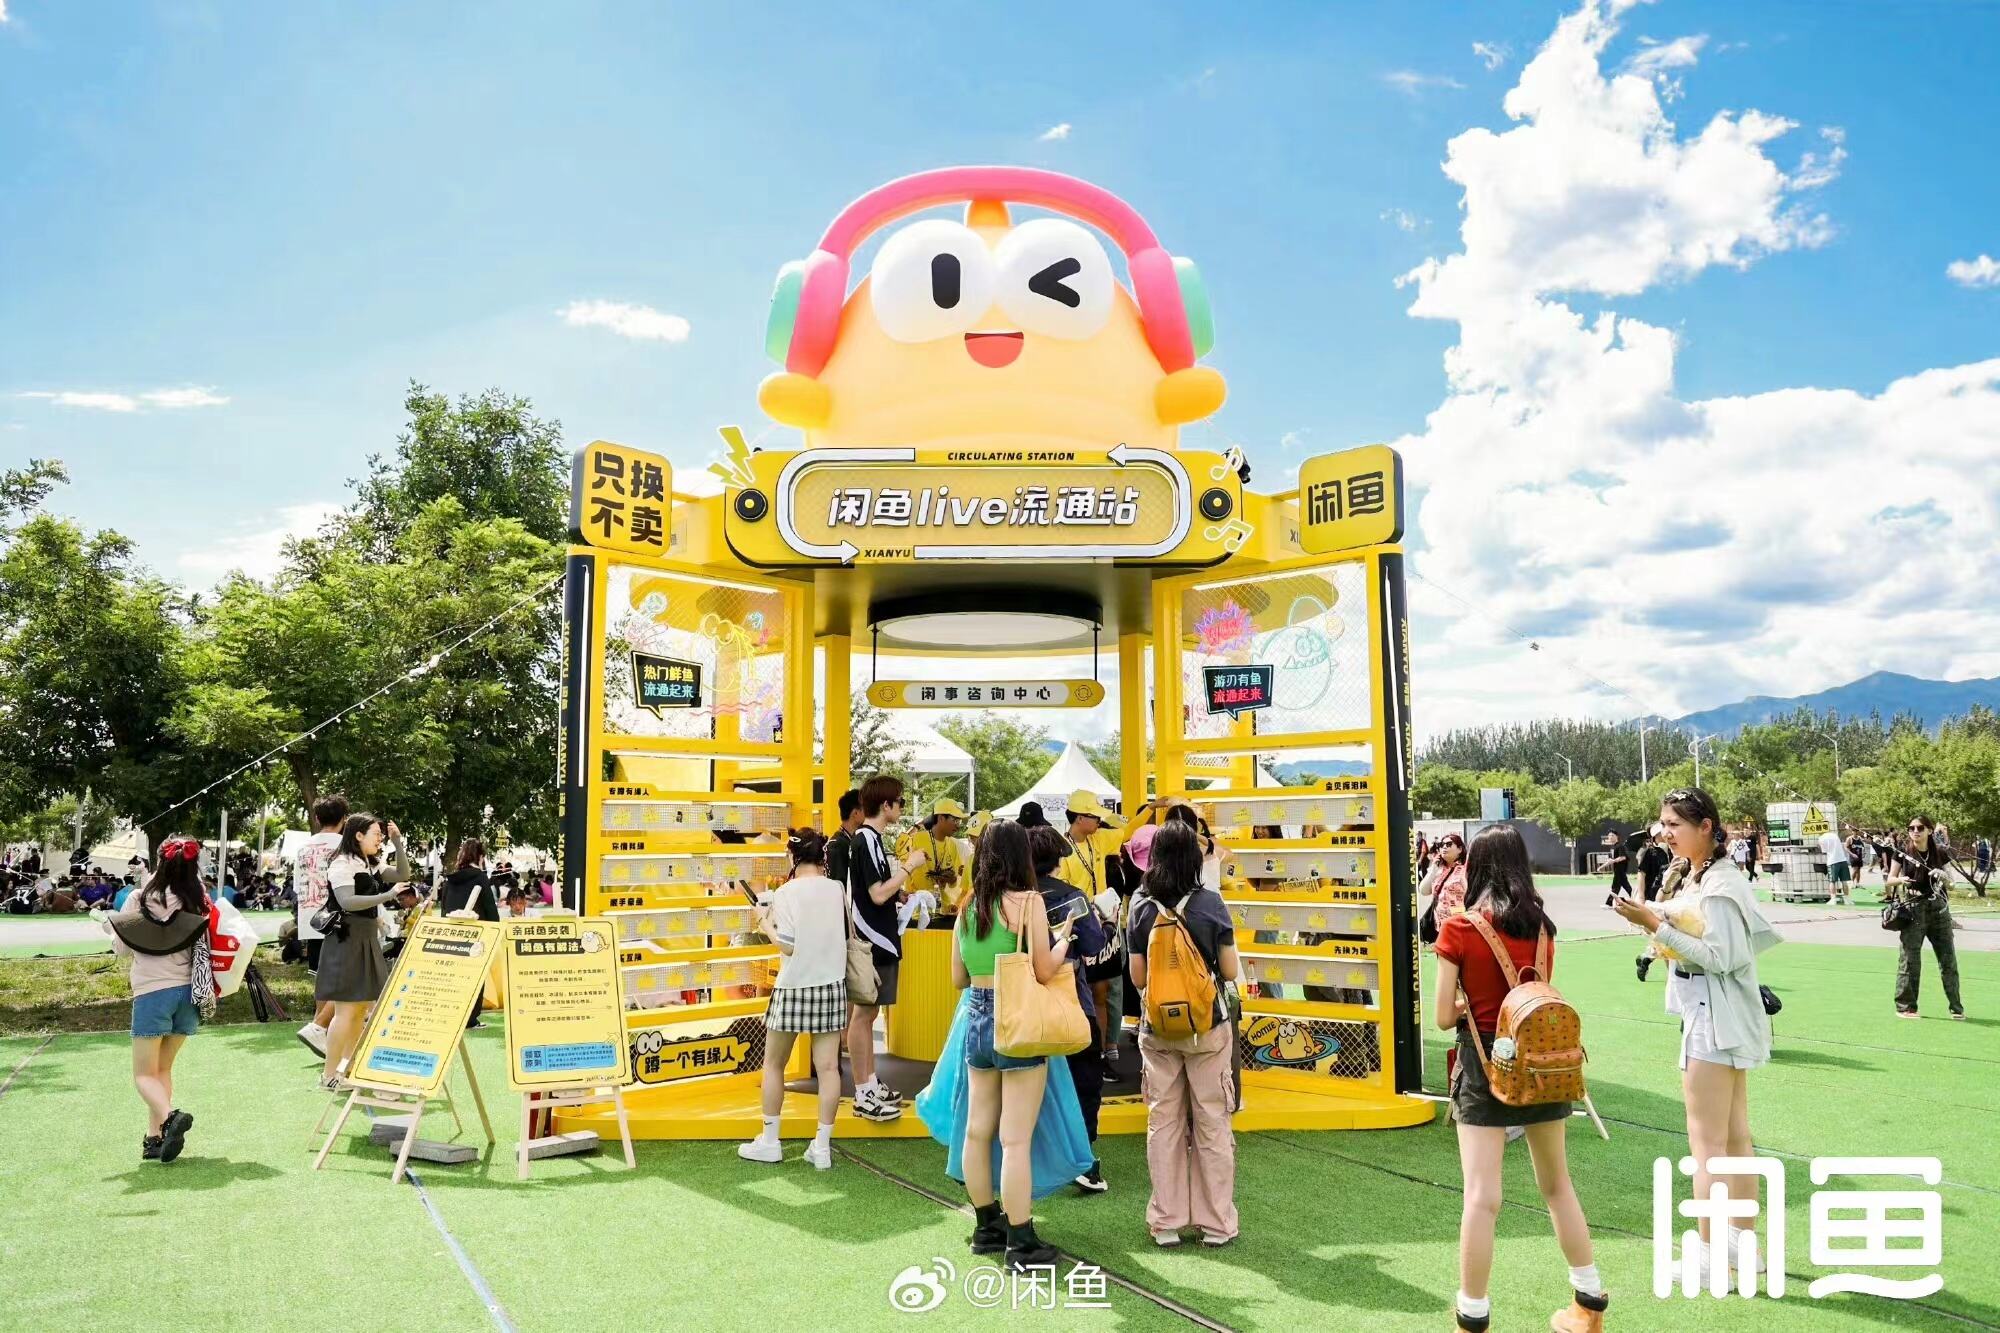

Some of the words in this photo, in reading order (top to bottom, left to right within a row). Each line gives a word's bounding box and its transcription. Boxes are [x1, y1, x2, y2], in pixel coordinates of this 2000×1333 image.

[947, 451, 1023, 461] CIRCULATING
[1027, 452, 1075, 461] STATION
[591, 450, 665, 503] 只换
[827, 485, 1140, 528] 闲鱼live流通站
[1307, 470, 1385, 526] 闲鱼
[590, 495, 664, 546] 不卖
[864, 549, 911, 558] XIANYU
[562, 620, 571, 678] XIANYU
[643, 664, 694, 682] 热门鲜鱼
[1213, 671, 1262, 688] 游刃有鱼
[643, 681, 694, 698] 流通起来
[920, 685, 1052, 702] 闲事咨询中心
[1213, 686, 1263, 703] 流通起来
[559, 726, 568, 785] XIANYU
[1408, 827, 1417, 885] XIANYU
[1411, 934, 1420, 992] XIANYU
[1251, 1021, 1277, 1041] HOMIE
[644, 1045, 736, 1075] 蹲一个有缘人
